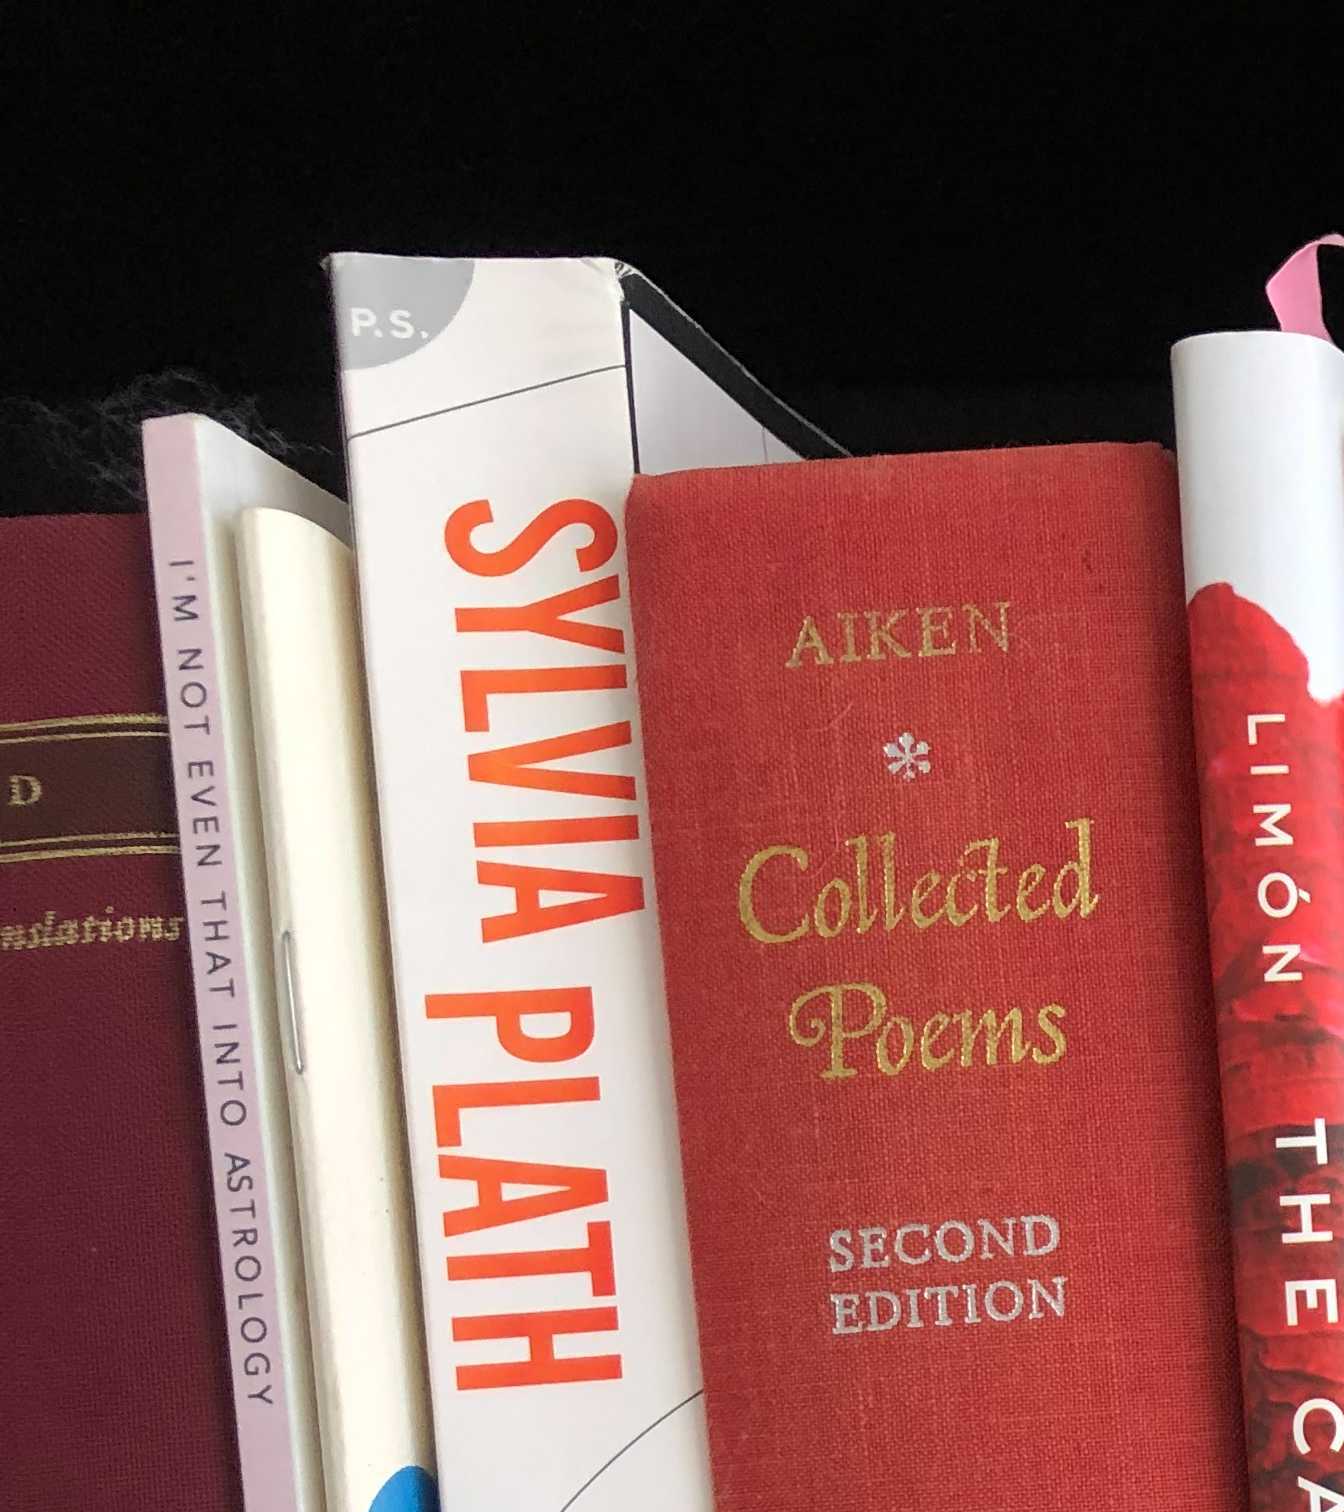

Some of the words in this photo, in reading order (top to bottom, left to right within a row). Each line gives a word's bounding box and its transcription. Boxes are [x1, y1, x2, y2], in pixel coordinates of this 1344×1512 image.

[351, 306, 429, 339] P.S.
[169, 559, 199, 623] I'M
[786, 601, 1011, 668] AIKEN
[178, 647, 211, 736] NOT
[443, 498, 645, 944] SYLVIA
[188, 761, 222, 868] EVEN
[1246, 712, 1311, 983] LIMÓN
[738, 818, 1099, 944] Collected
[198, 891, 236, 998] THAT
[212, 1023, 247, 1127] INTO
[788, 981, 1067, 1080] Poems
[424, 986, 623, 1391] PLATH
[1275, 1118, 1339, 1326] THE
[224, 1152, 274, 1406] ASTROLOGY
[827, 1214, 1061, 1272] SECOND
[832, 1276, 1068, 1334] EDITION
